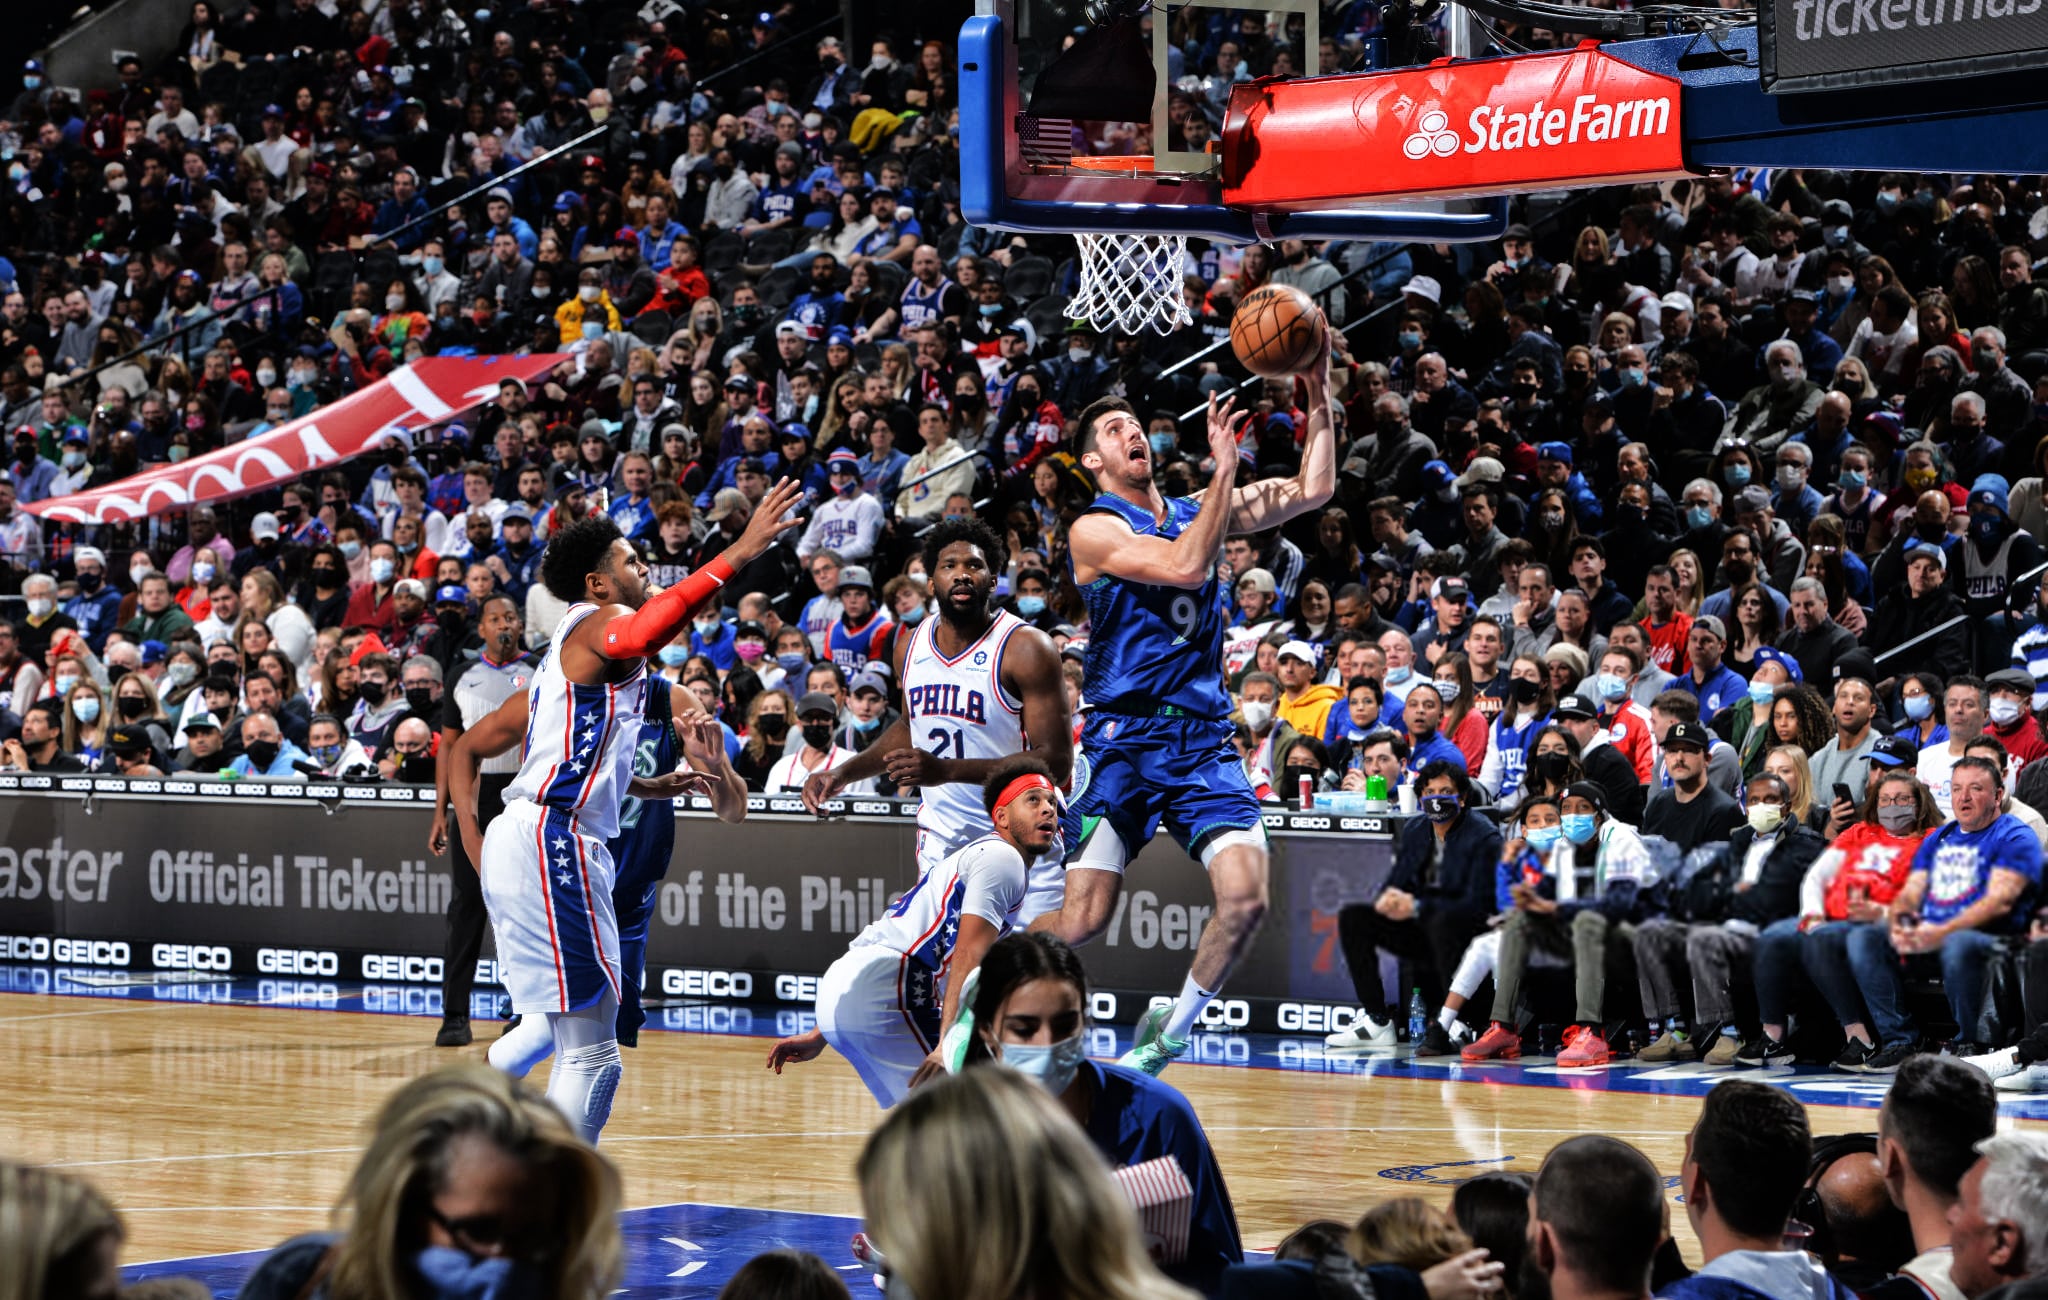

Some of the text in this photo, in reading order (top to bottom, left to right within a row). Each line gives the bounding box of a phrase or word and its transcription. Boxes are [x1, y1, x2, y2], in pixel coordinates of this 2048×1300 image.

[1171, 595, 1197, 646] 9
[909, 684, 987, 726] PHILA
[928, 728, 965, 760] 21
[1676, 725, 1686, 737] G
[306, 785, 339, 798] GEICO
[343, 786, 377, 799] GEICO
[380, 787, 414, 800] GEICO
[853, 801, 890, 814] GEICO
[1290, 816, 1331, 830] GEICO
[1340, 817, 1382, 832] GEICO
[150, 849, 1213, 951] Official Ticketin of the Phil 76er
[0, 935, 50, 961] EICO
[53, 938, 131, 967] GEICO
[152, 943, 232, 971] GEICO
[257, 948, 339, 976] GEICO
[362, 954, 444, 982] GEICO
[662, 968, 753, 998] GEICO
[1277, 1003, 1364, 1032] GEIC
